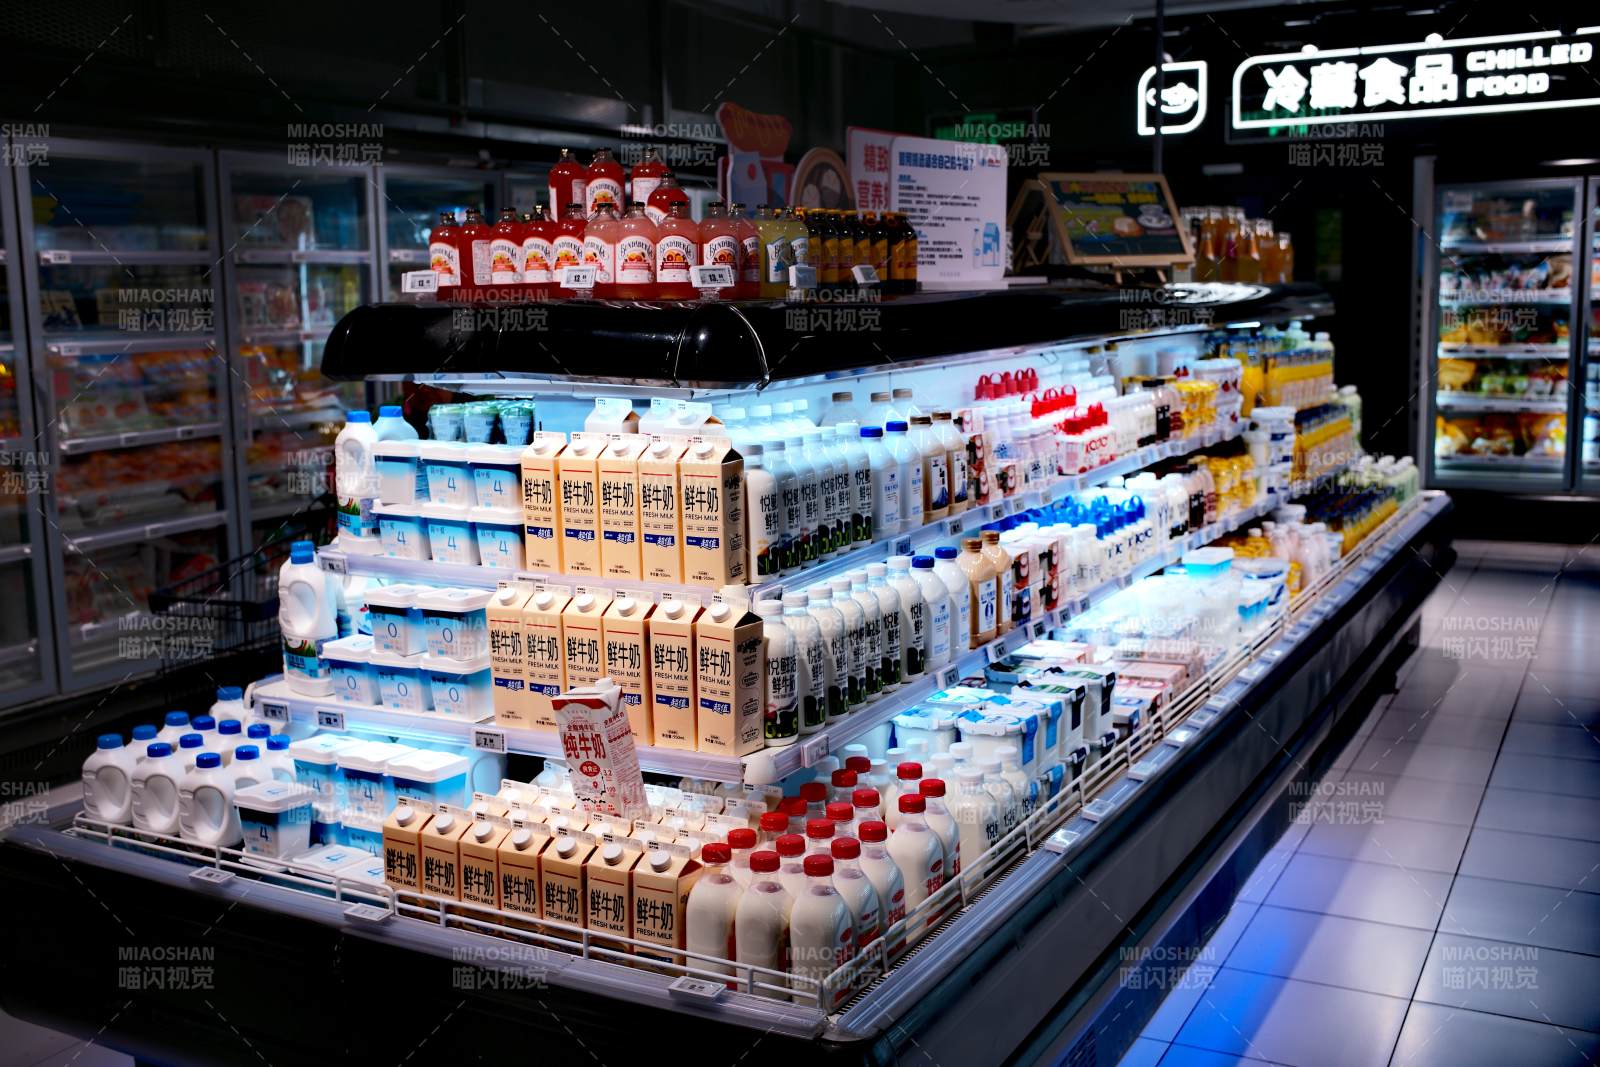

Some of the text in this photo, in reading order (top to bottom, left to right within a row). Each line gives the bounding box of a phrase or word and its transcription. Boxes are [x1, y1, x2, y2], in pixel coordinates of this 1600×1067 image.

[1466, 42, 1593, 72] CHILLED
[1262, 53, 1458, 112] 冷藏食品
[1466, 72, 1550, 98] FOOD
[447, 477, 456, 492] 4
[493, 480, 504, 495] 4
[524, 478, 552, 504] 鲜牛奶
[563, 479, 594, 507] 鲜牛奶
[603, 481, 634, 507] 鲜牛奶
[642, 483, 674, 510] 鲜牛奶
[685, 485, 719, 513] 鲜牛奶
[397, 531, 406, 545] 4
[447, 536, 456, 550] 4
[499, 540, 509, 555] 4
[490, 629, 522, 656] 鲜牛奶
[527, 633, 558, 661] 鲜牛奶
[567, 636, 599, 664] 鲜牛奶
[607, 641, 640, 669] 鲜牛奶
[654, 643, 689, 672] 鲜牛奶
[700, 646, 731, 677] 鲜牛奶
[655, 672, 689, 681] FRESH MILK
[717, 678, 731, 686] MILK
[564, 732, 606, 760] 纯牛奶
[312, 778, 321, 792] 4
[364, 786, 373, 801] 4
[259, 825, 269, 841] 4
[386, 848, 417, 879] 鲜牛奶
[425, 856, 454, 889] 鲜牛奶
[387, 875, 417, 887] FRESH MILK
[425, 884, 454, 896] FRESH MILK
[463, 864, 494, 896] 鲜牛奶
[503, 873, 536, 905] 鲜牛奶
[464, 893, 494, 905] FRESH MILK
[504, 902, 536, 914] FRESH MILK
[545, 881, 578, 915] 鲜牛奶
[590, 889, 624, 923] 鲜牛奶
[546, 911, 578, 924] FRESH MILK
[590, 919, 624, 932] FRESH MILK
[637, 897, 673, 931] 鲜牛奶
[637, 927, 673, 940] FRESH MILK
